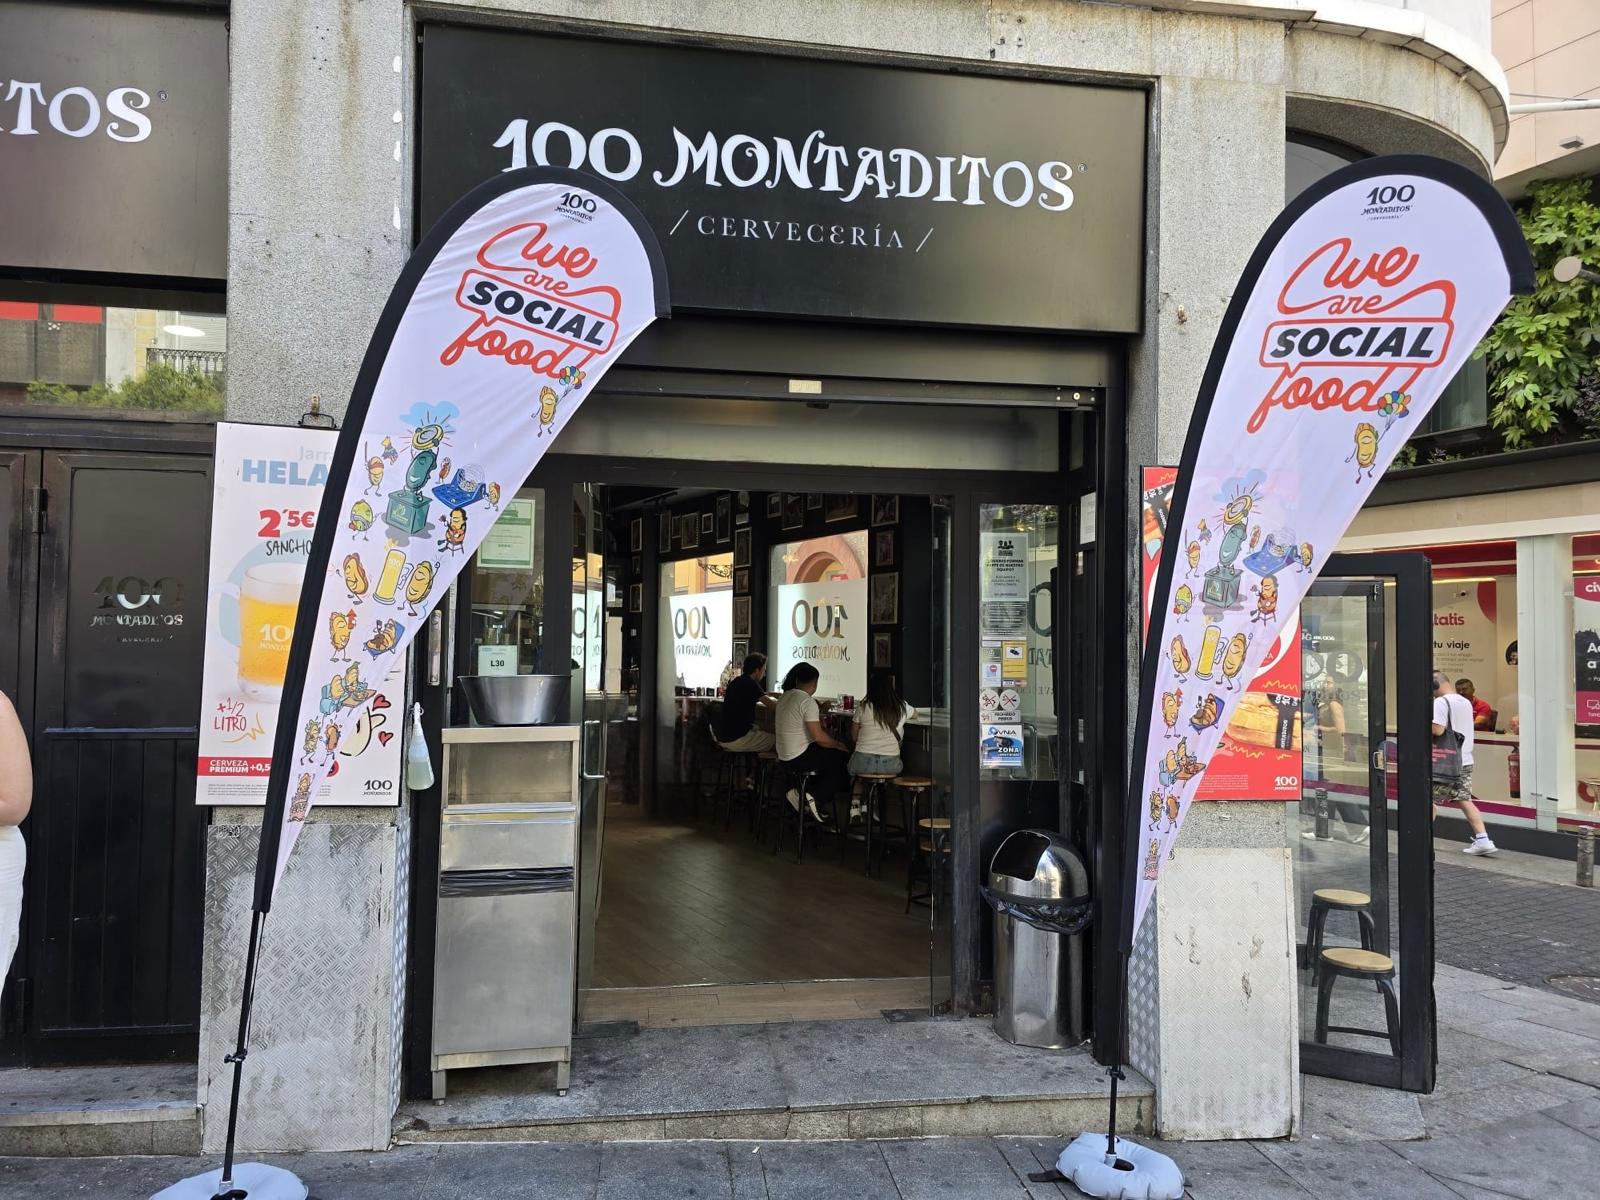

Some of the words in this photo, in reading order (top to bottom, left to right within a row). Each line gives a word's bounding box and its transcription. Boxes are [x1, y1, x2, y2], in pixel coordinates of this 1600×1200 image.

[0, 79, 152, 143] TOS
[492, 118, 643, 182] 100
[653, 125, 1074, 212] MONTADITOS
[561, 192, 597, 213] 100
[1366, 184, 1416, 206] 100
[1360, 205, 1411, 216] MONTADITOS
[698, 214, 904, 249] CERVECERÍA
[523, 270, 569, 296] are
[466, 280, 606, 346] SOCIAL
[1328, 294, 1384, 316] are
[1269, 326, 1434, 359] SOCIAL
[242, 458, 329, 486] HELA
[1446, 640, 1470, 650] viaje
[490, 659, 506, 668] L30
[214, 715, 247, 732] LITRO
[209, 766, 249, 774] PREMIUM
[1274, 776, 1298, 786] 100
[364, 779, 393, 791] 100
